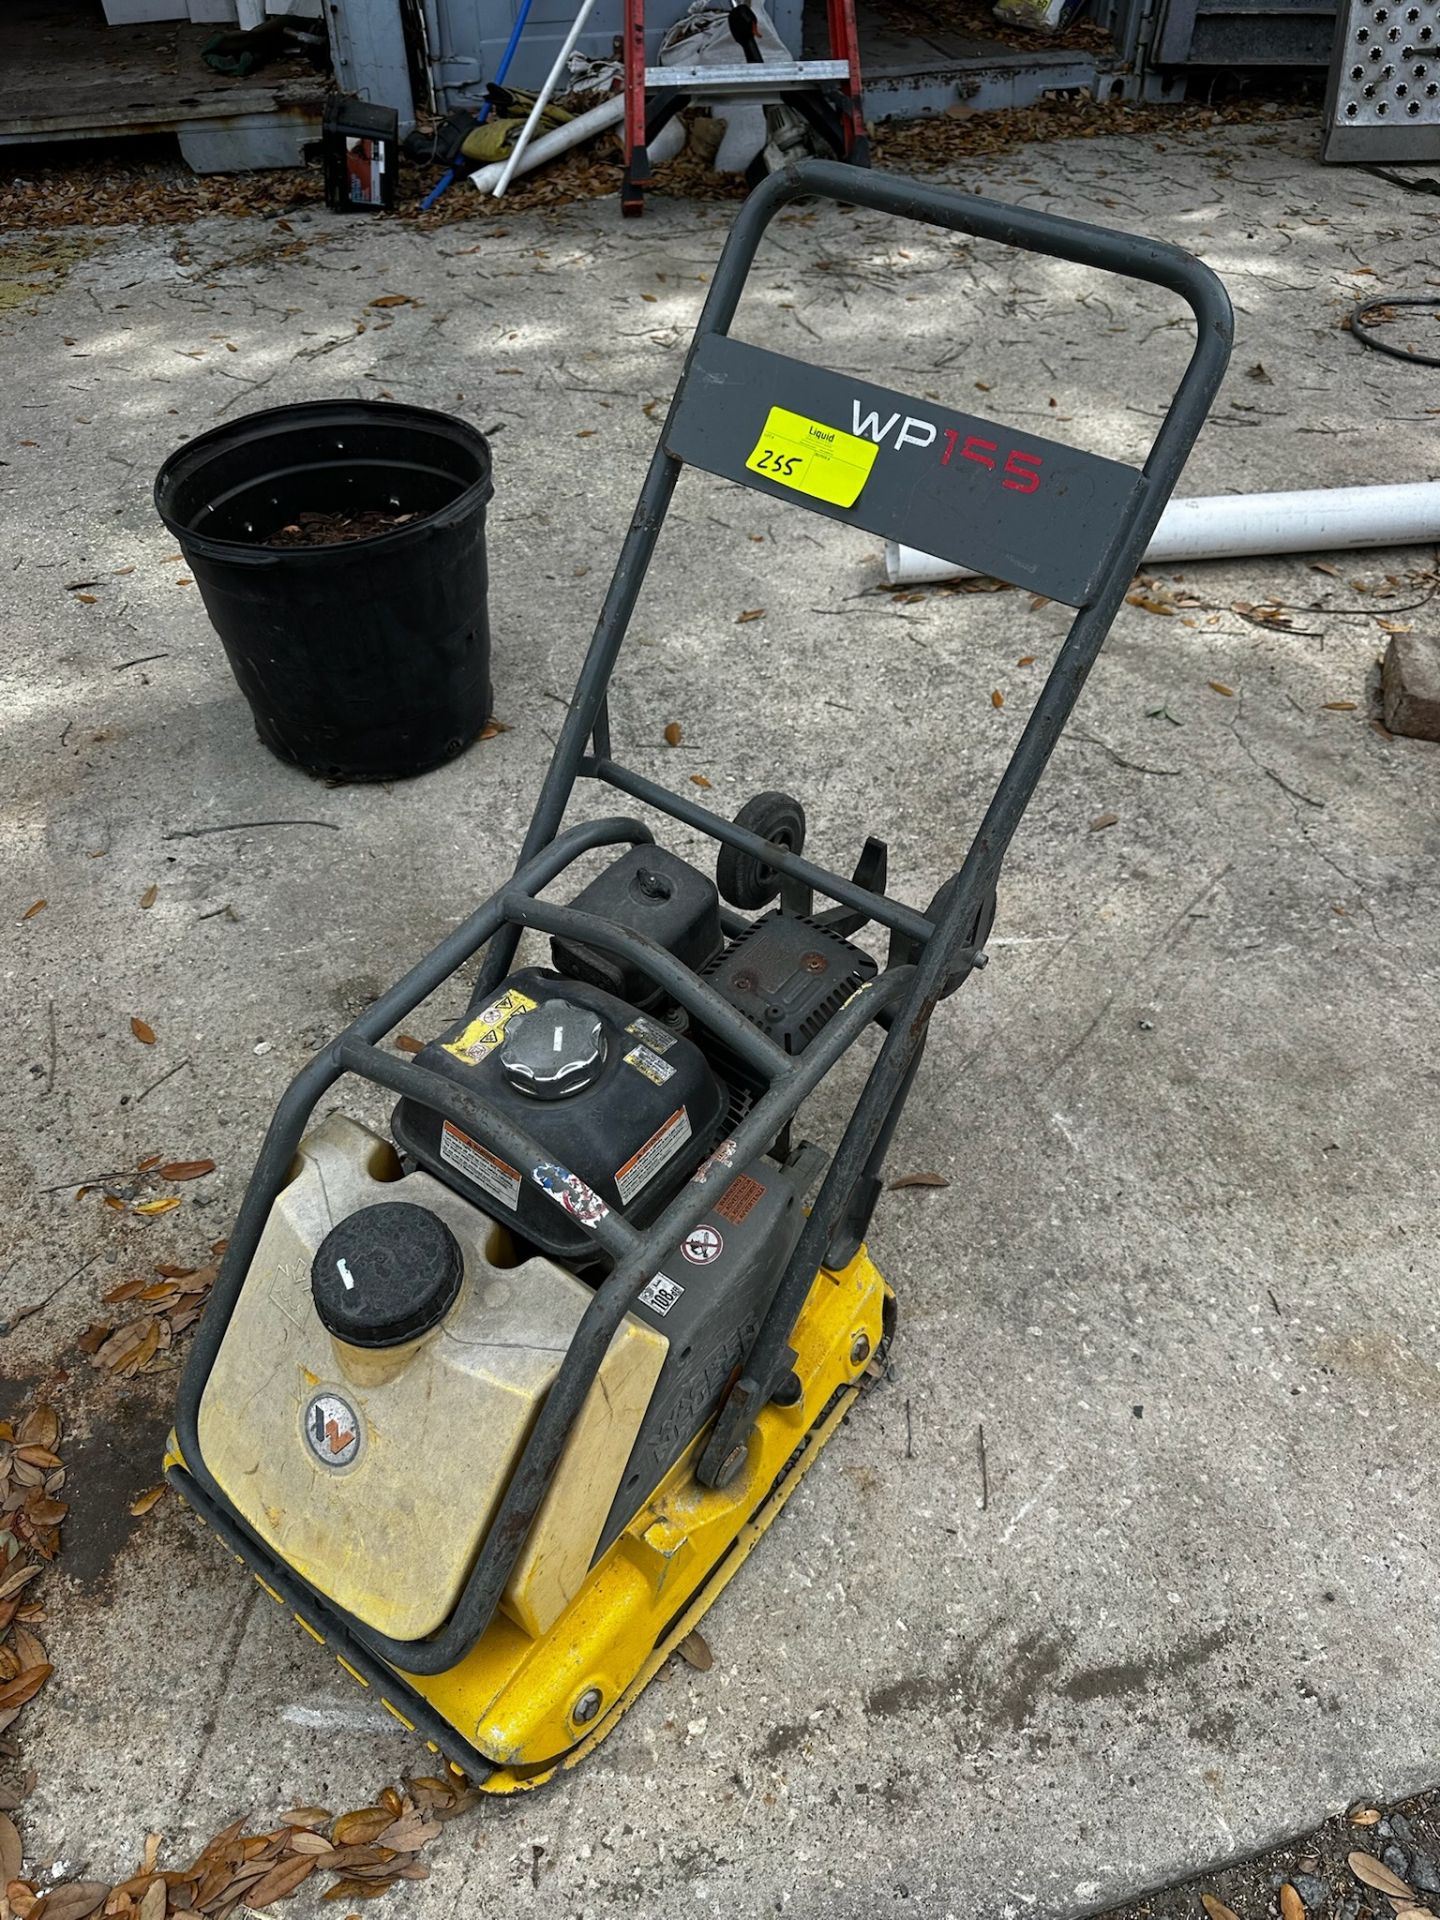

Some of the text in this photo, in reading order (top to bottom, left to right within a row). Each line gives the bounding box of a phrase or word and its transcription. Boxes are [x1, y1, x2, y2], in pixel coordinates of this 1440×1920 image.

[808, 425, 836, 443] Liquid
[852, 399, 1044, 495] WP155
[651, 1288, 674, 1310] 108
